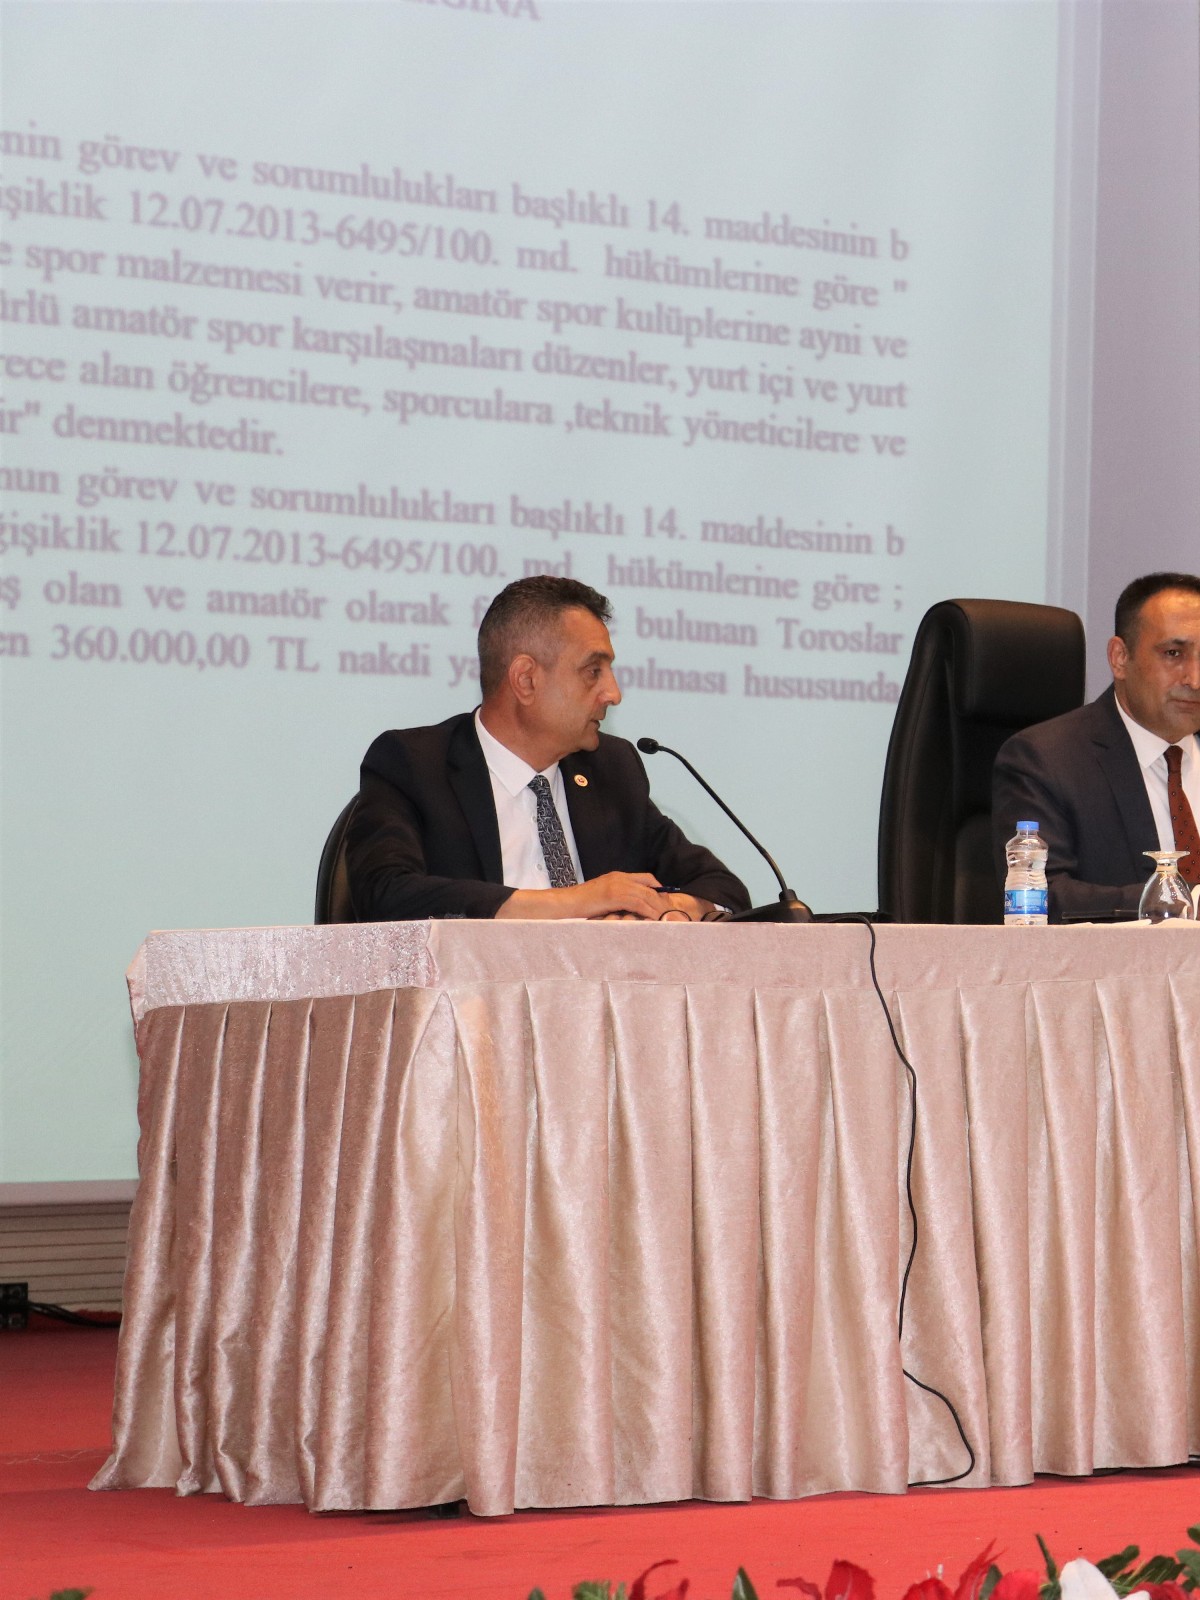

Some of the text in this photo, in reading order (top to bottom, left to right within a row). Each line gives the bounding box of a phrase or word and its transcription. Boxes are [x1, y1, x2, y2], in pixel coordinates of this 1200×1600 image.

[78, 134, 181, 176] görev
[196, 154, 238, 182] ve
[252, 161, 498, 214] sorumlulukları
[512, 182, 630, 229] başlıklı
[647, 198, 690, 236] 14.
[704, 211, 879, 259] maddesinin
[890, 228, 909, 261] b
[130, 189, 500, 266] 12.07.2013-6495/100.
[516, 239, 578, 273] md.
[604, 244, 801, 297] hükümlerine
[812, 274, 879, 312] göre
[24, 244, 107, 284] spor
[115, 248, 304, 296] malzemesi
[314, 271, 403, 314] verir,
[413, 286, 529, 320] amatör
[536, 299, 608, 335] spor
[615, 297, 791, 349] kulüplerine
[798, 323, 863, 362] ayni
[872, 335, 909, 359] ve
[0, 354, 68, 383] ece
[79, 350, 156, 391] alan
[167, 360, 372, 416] öğrencilere,
[382, 387, 555, 426] sporculara
[682, 410, 862, 455] yöneticilere
[870, 434, 906, 457] ve
[71, 304, 199, 340] amatör
[207, 318, 285, 355] spor
[292, 315, 524, 372] karşılaşmaları
[532, 341, 678, 393] düzenler,
[686, 365, 750, 398] yurt
[758, 362, 795, 405] içi
[803, 377, 839, 403] ve
[846, 382, 908, 415] yurt
[51, 403, 284, 456] denmektedir.
[76, 466, 180, 509] görev
[194, 480, 237, 507] ve
[250, 482, 497, 526] sorumlulukları
[510, 494, 626, 541] başlıklı
[644, 505, 687, 540] 14.
[700, 514, 875, 555] maddesinin
[886, 524, 905, 556] b
[42, 570, 124, 609] olan
[143, 585, 187, 612] ve
[206, 587, 329, 621] amatör
[344, 589, 452, 627] olarak
[635, 606, 759, 648] bulunan
[776, 616, 905, 655] Toroslar
[137, 520, 505, 578] 12.07.2013-6495/100.
[607, 553, 800, 600] hükümlerine
[811, 574, 880, 612] göre
[49, 623, 252, 672] 360.000,00
[267, 635, 320, 673] TL
[338, 641, 432, 678] nakdi
[743, 665, 898, 703] hususunda
